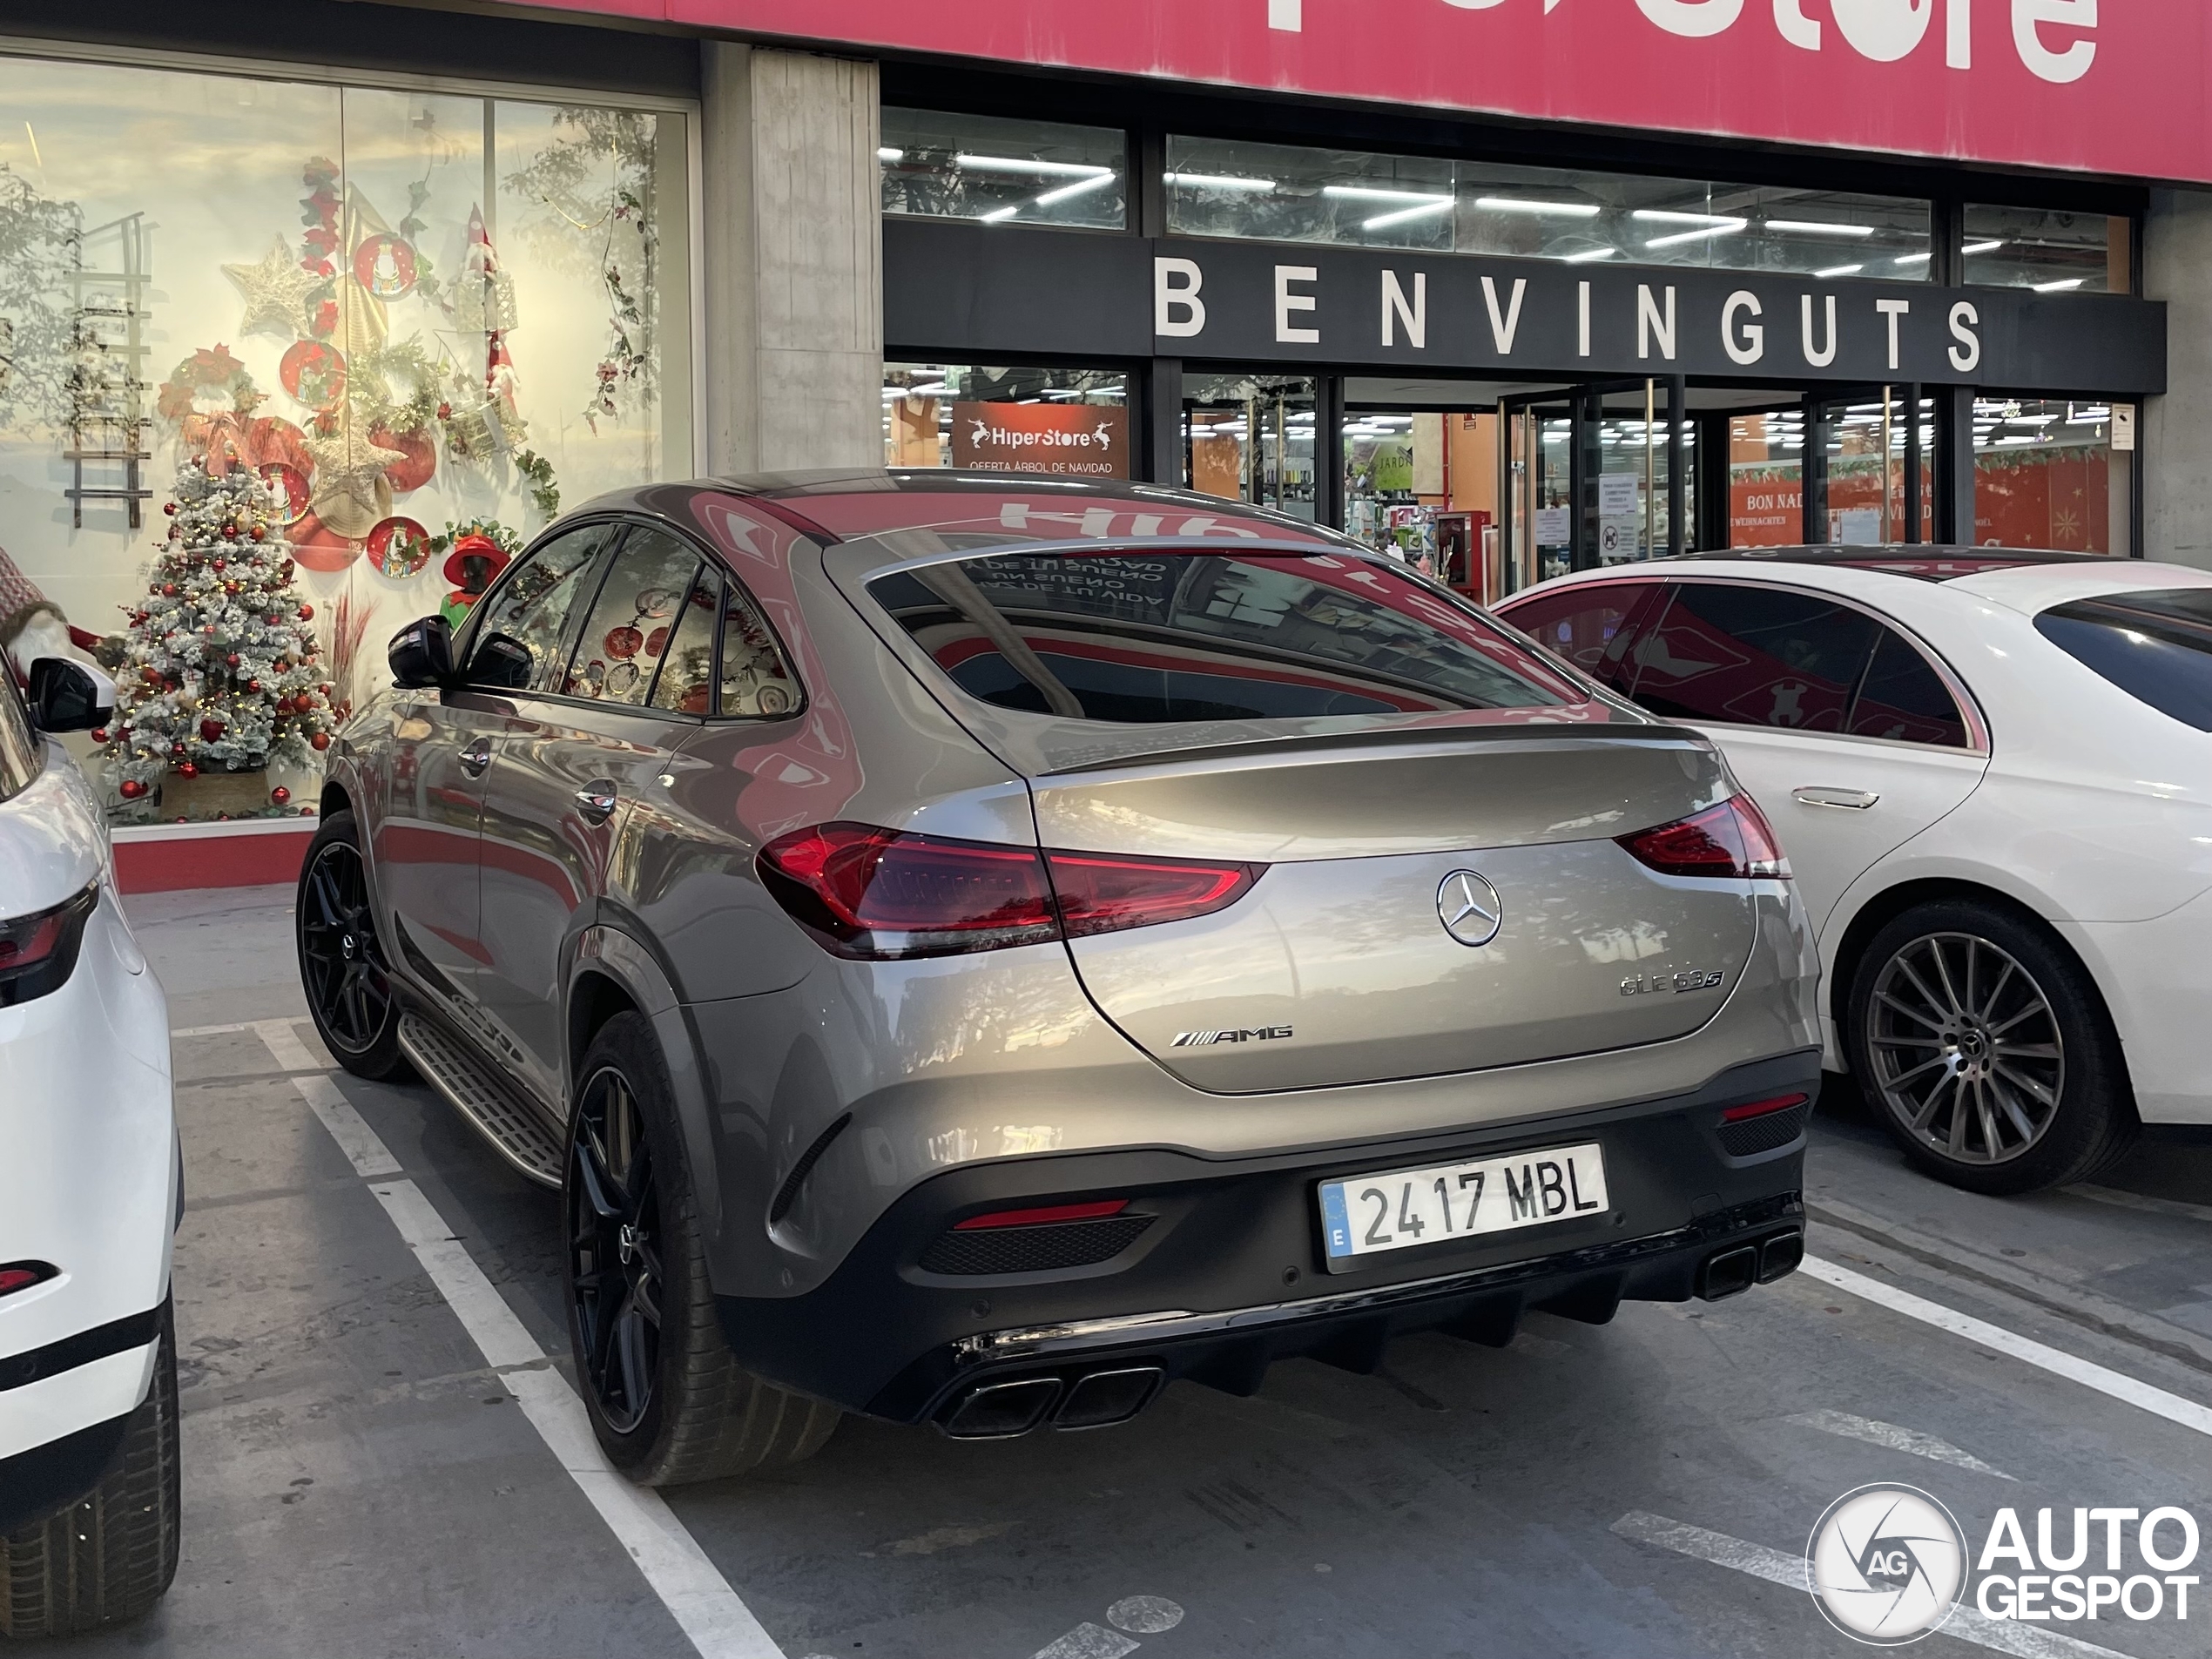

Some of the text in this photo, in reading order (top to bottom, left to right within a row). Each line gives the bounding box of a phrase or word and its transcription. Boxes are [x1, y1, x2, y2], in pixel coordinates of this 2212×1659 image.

[1154, 256, 1980, 373] BENVINGUTS
[969, 461, 1011, 470] OFERTA
[1051, 462, 1066, 473] DE
[1069, 462, 1113, 474] NAVIDAD
[1747, 495, 1774, 510] BON
[1620, 974, 1668, 996] GLE
[1211, 1025, 1293, 1044] AMG
[1359, 1157, 1598, 1246] 2417 MBL
[1332, 1229, 1344, 1246] E
